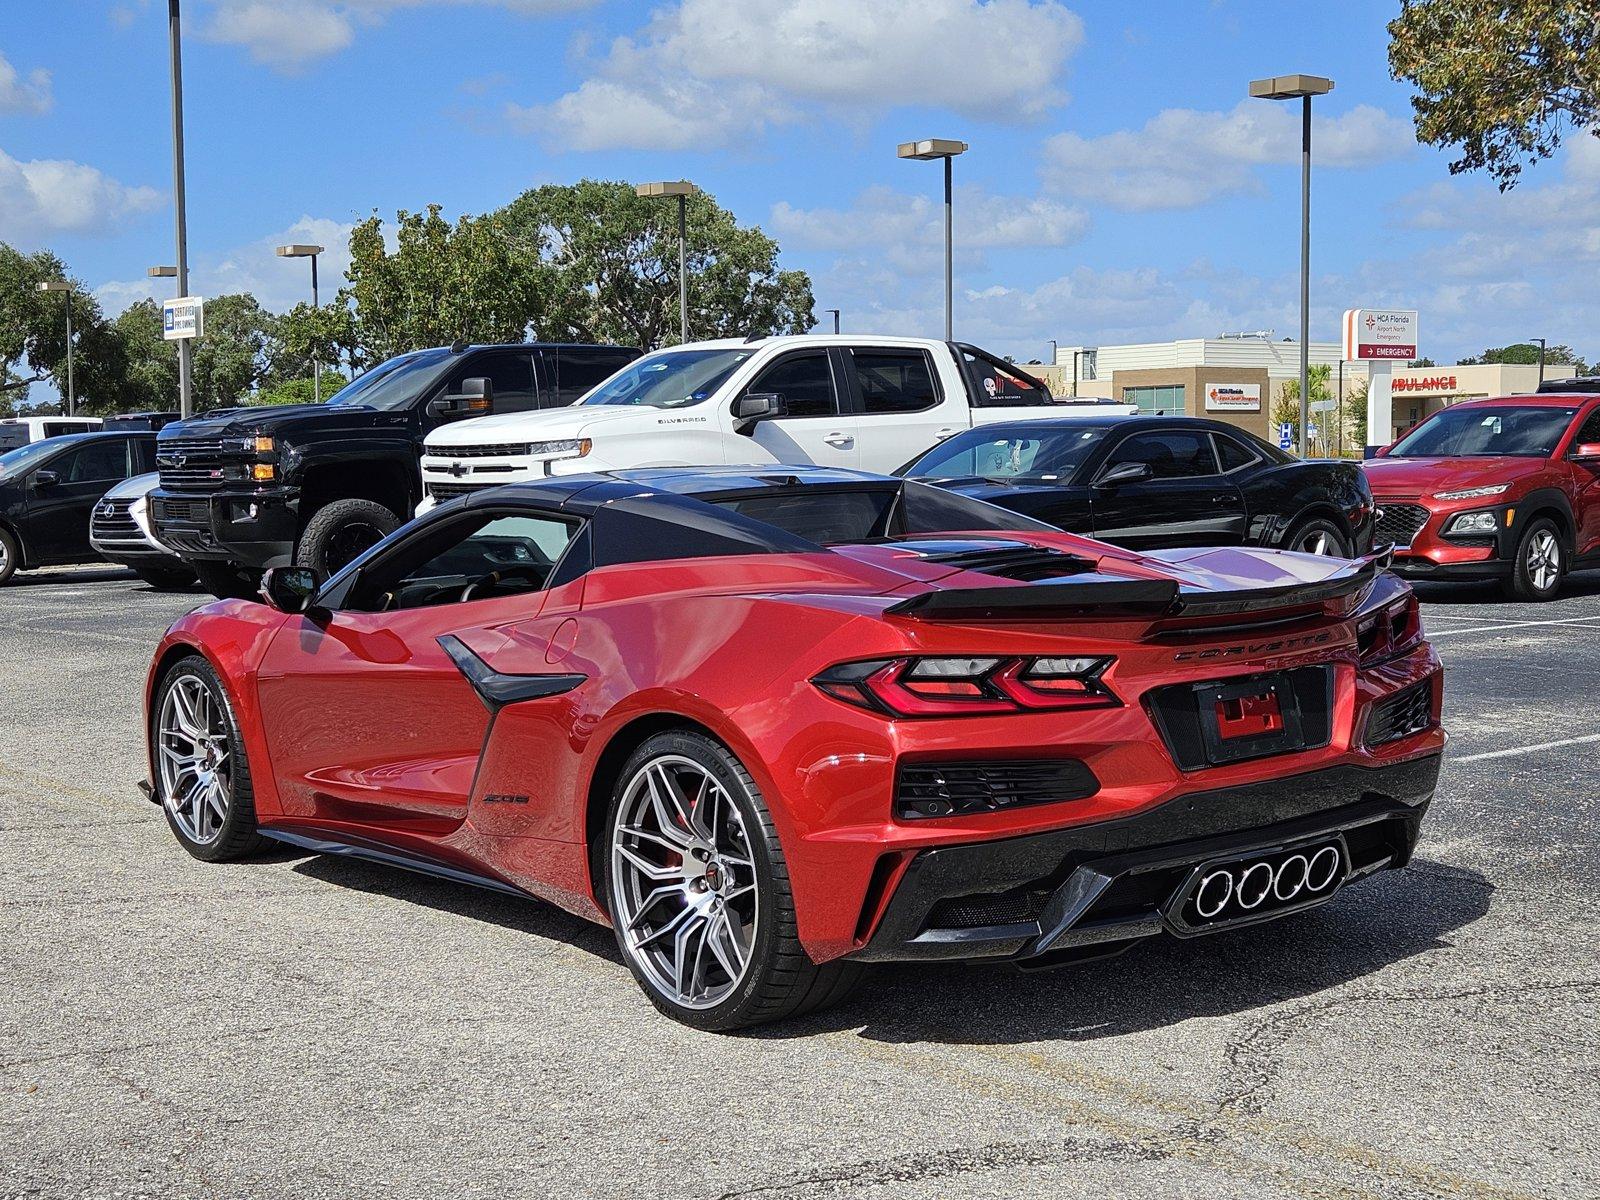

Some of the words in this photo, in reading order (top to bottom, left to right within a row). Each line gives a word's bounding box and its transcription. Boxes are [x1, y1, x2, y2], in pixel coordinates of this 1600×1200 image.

[1376, 315, 1389, 323] HCA
[1390, 315, 1410, 323] Florida
[1376, 348, 1413, 356] EMERGENCY
[657, 416, 707, 424] SILVERADO
[1281, 423, 1291, 438] H
[1174, 632, 1331, 661] CORVETTE
